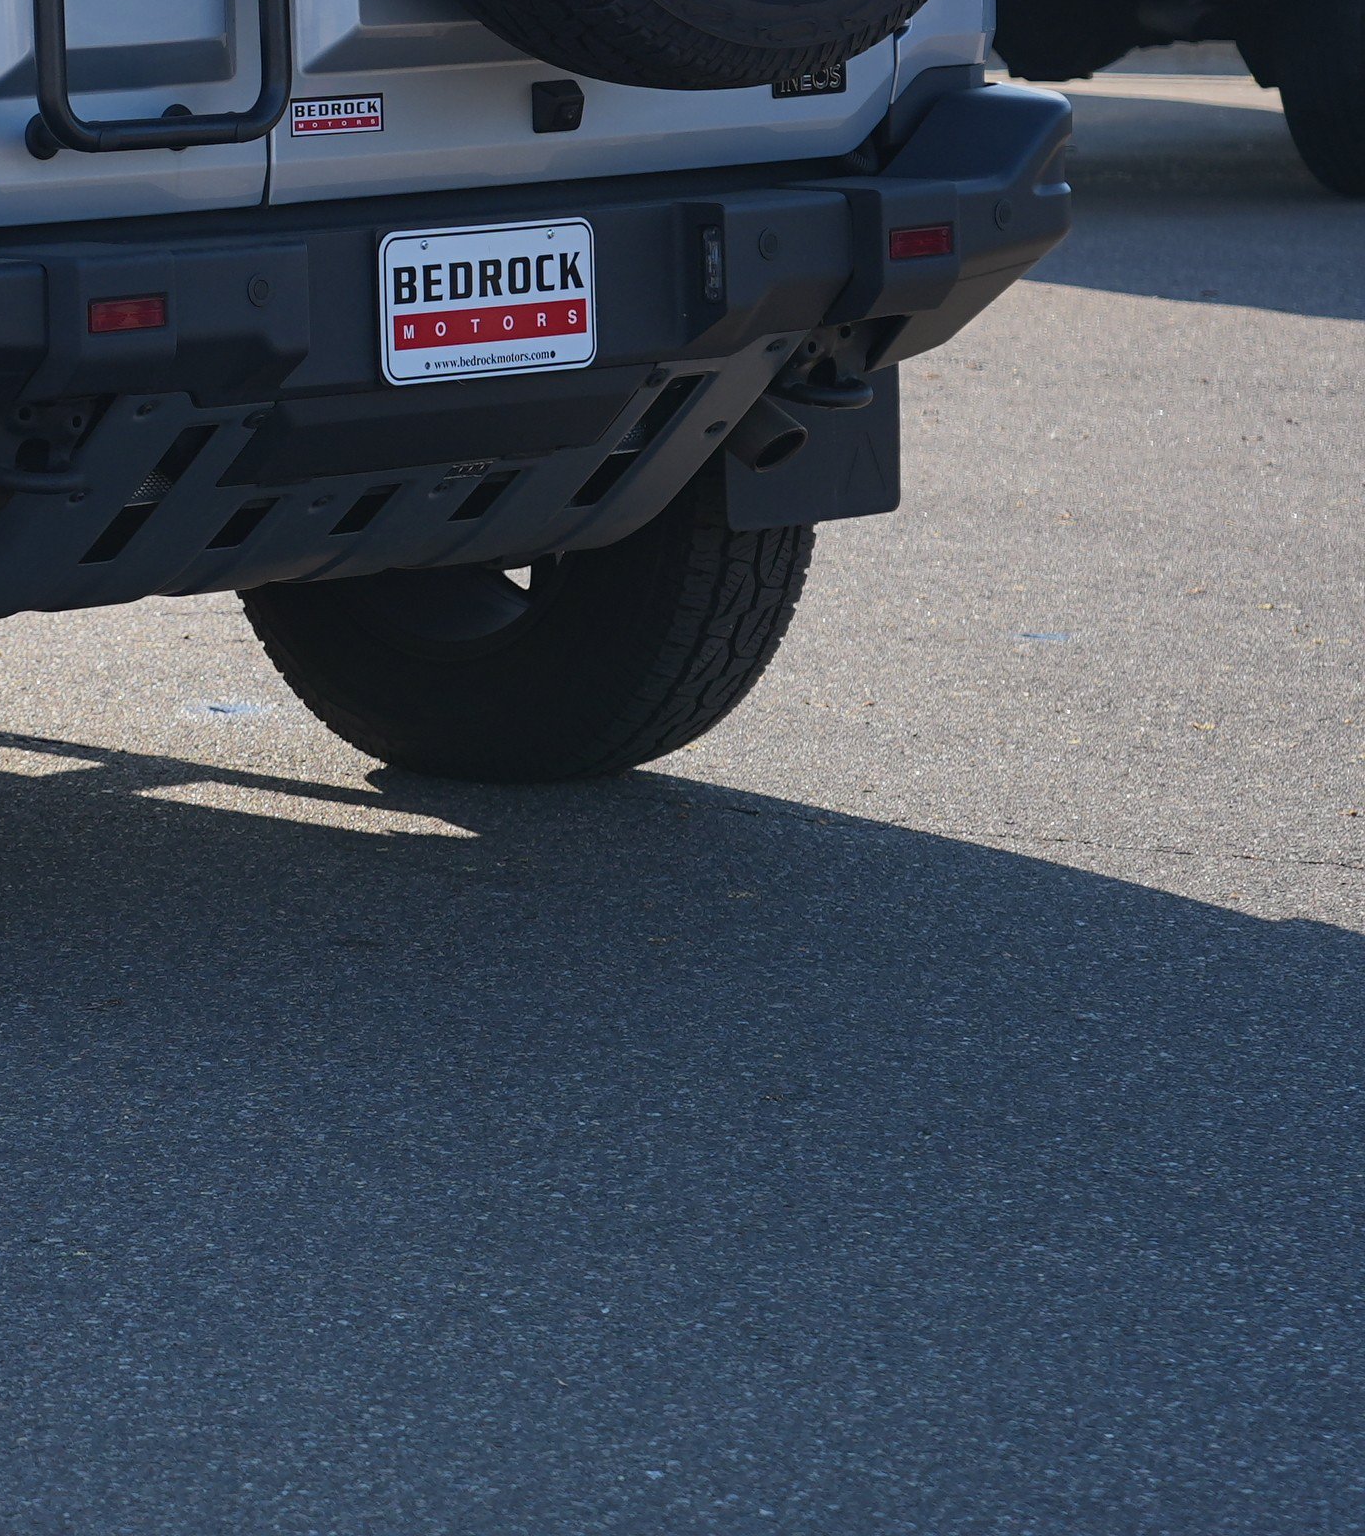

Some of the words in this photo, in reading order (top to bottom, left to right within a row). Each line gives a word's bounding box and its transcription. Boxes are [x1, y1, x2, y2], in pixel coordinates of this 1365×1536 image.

[294, 100, 379, 118] BEDROCK
[298, 117, 376, 129] MOTORS
[393, 251, 585, 305] BEDROCK
[402, 309, 578, 340] MOTORS
[434, 348, 550, 370] www.bedrockmotors.com
